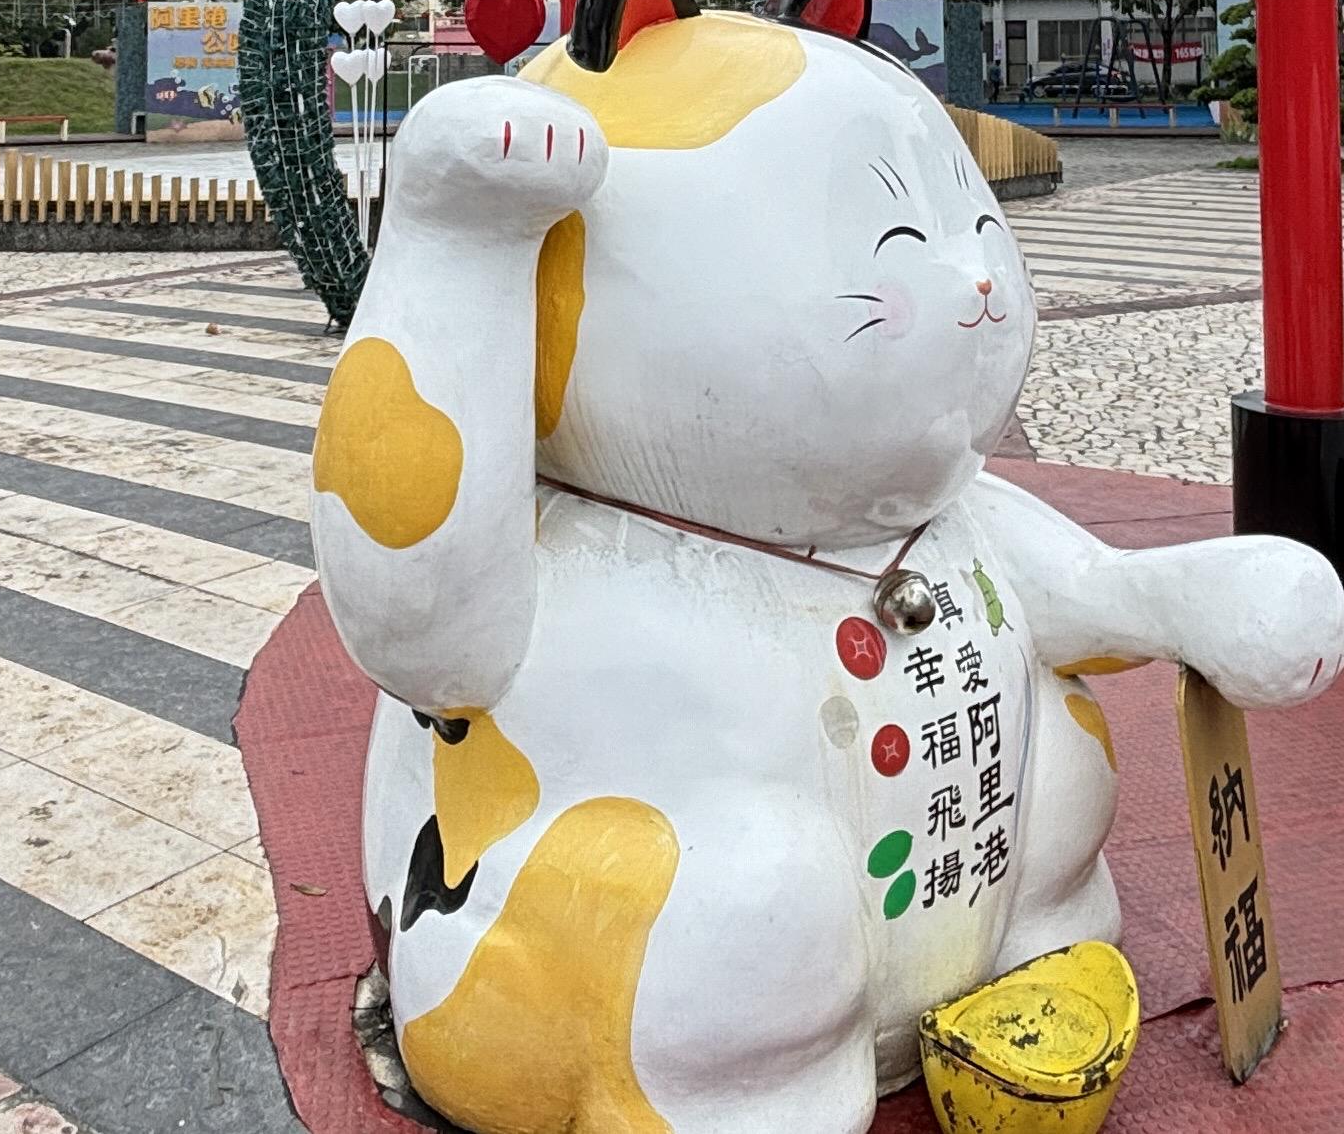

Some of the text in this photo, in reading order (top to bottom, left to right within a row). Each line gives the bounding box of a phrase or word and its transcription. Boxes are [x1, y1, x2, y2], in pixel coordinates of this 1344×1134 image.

[903, 646, 966, 909] 幸福飛揚
[931, 581, 1015, 908] 真愛阿里港
[1209, 763, 1268, 1004] 納福
